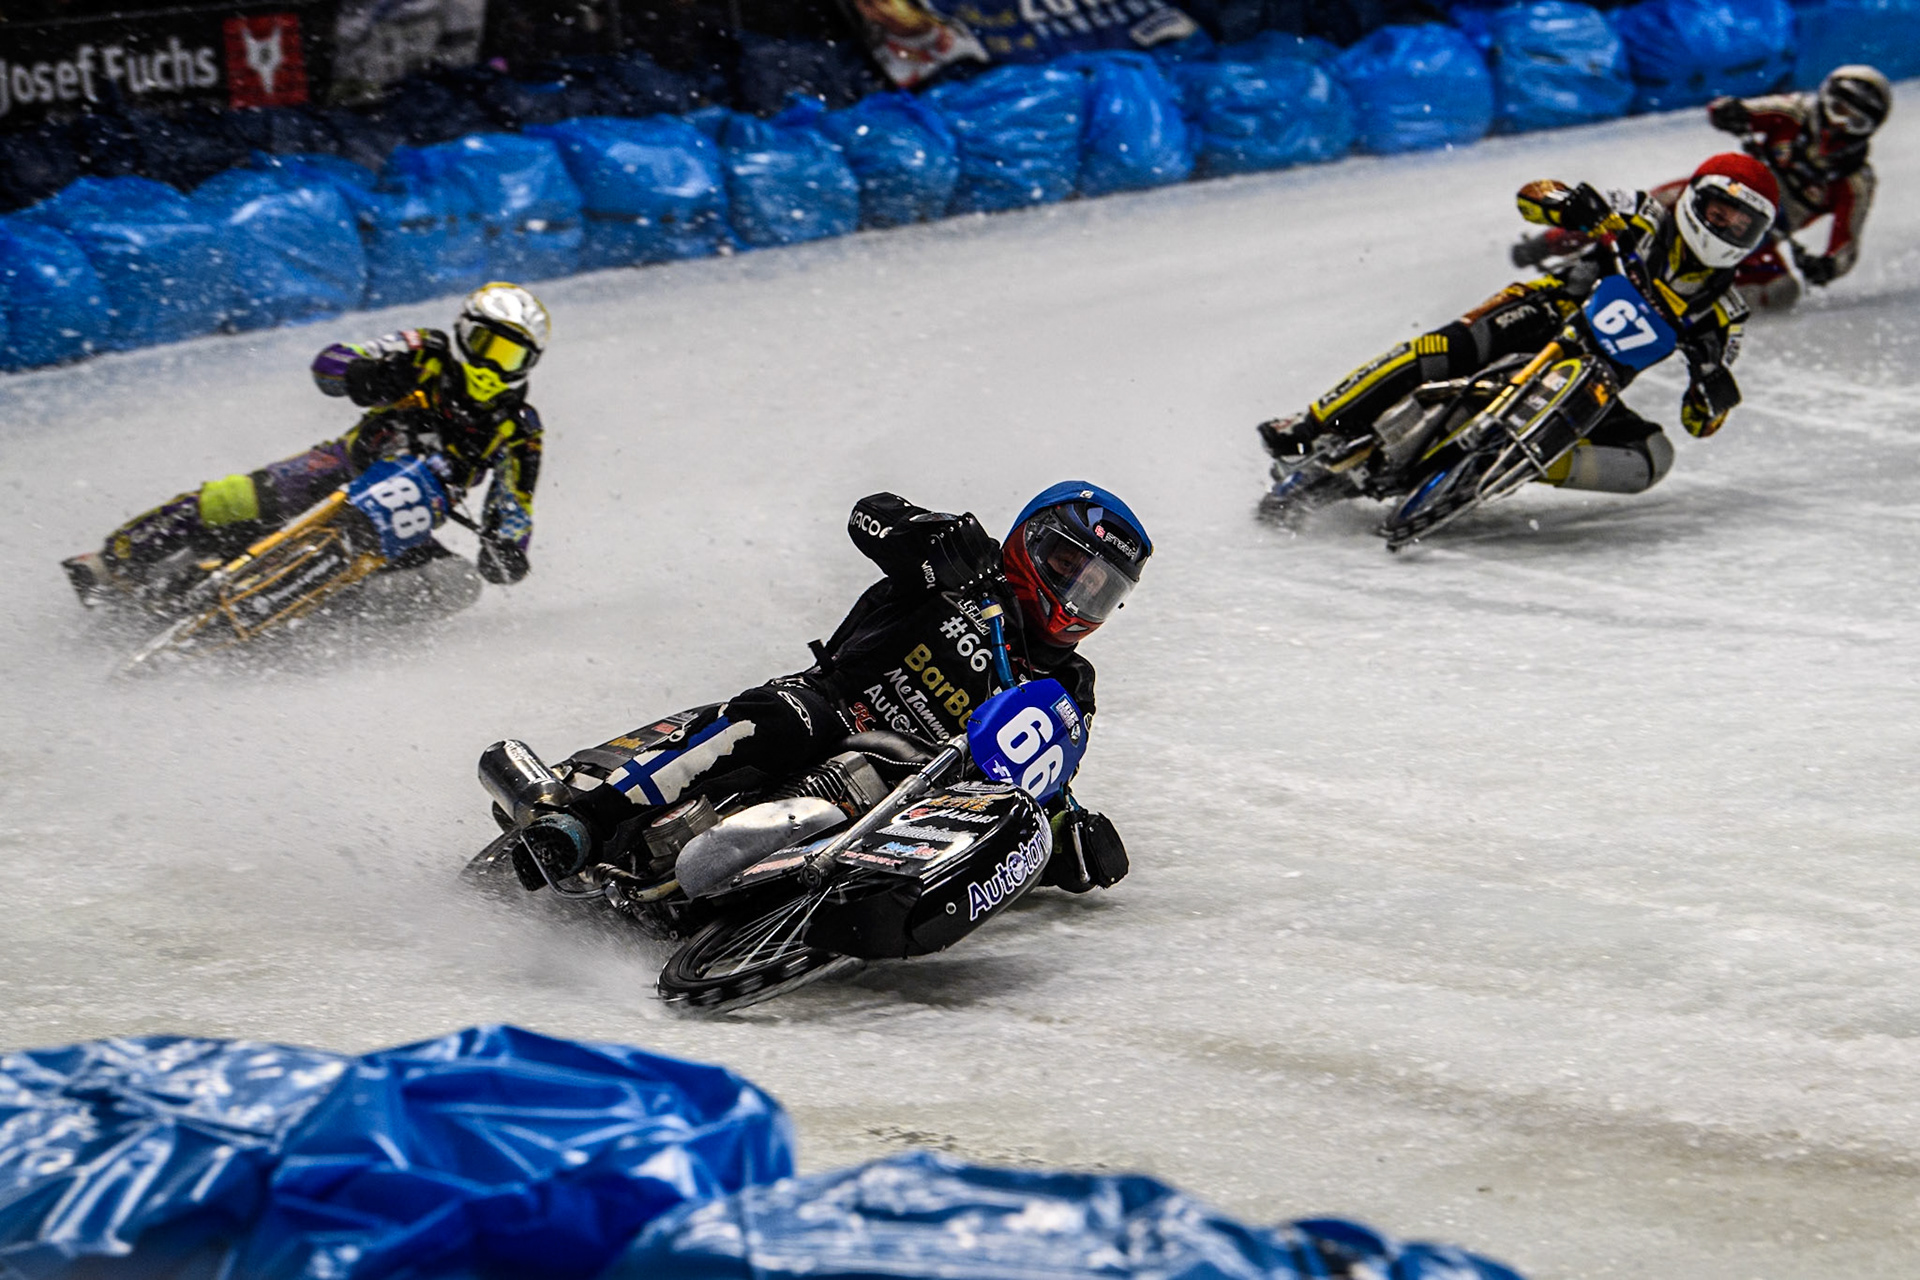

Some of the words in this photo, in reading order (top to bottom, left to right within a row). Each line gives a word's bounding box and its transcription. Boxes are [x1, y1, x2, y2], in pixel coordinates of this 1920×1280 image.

[102, 35, 219, 93] Fuchs
[1592, 299, 1658, 352] 67
[369, 476, 432, 540] 88
[939, 616, 993, 672] #66
[996, 706, 1064, 799] 66
